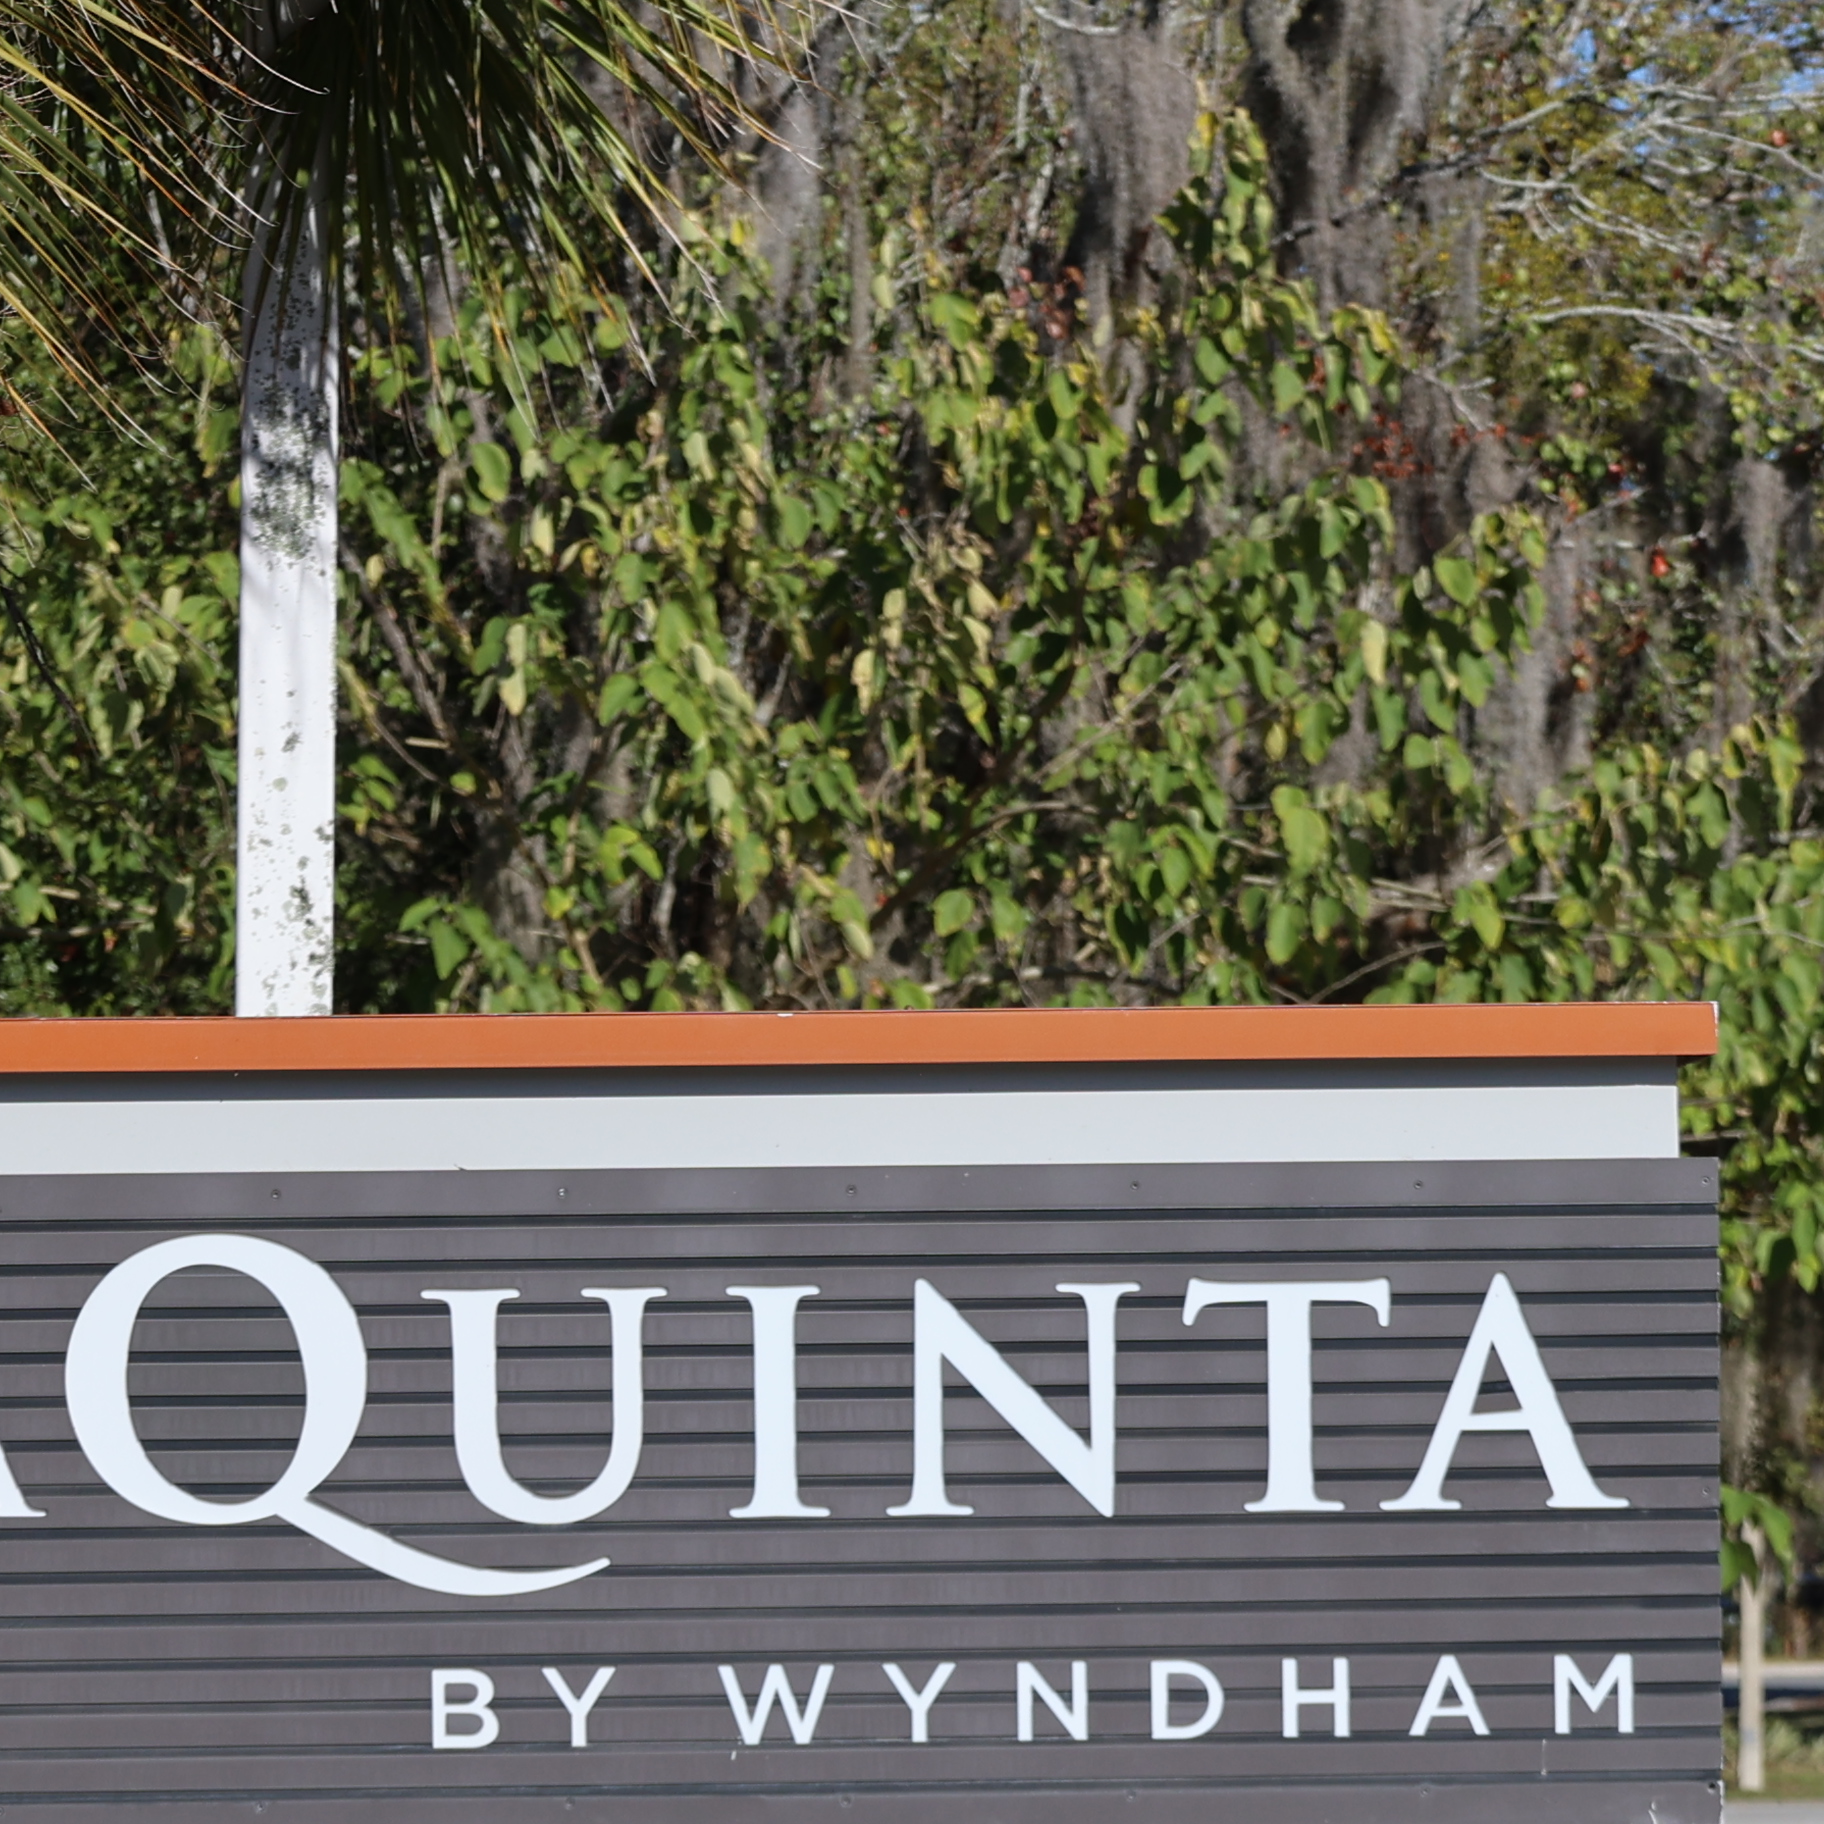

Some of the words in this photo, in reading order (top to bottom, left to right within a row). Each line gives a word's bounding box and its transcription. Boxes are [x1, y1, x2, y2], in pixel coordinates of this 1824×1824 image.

[63, 1232, 1631, 1598] QUINTA
[431, 1666, 617, 1750] BY
[717, 1653, 1637, 1746] WYNDHAM
